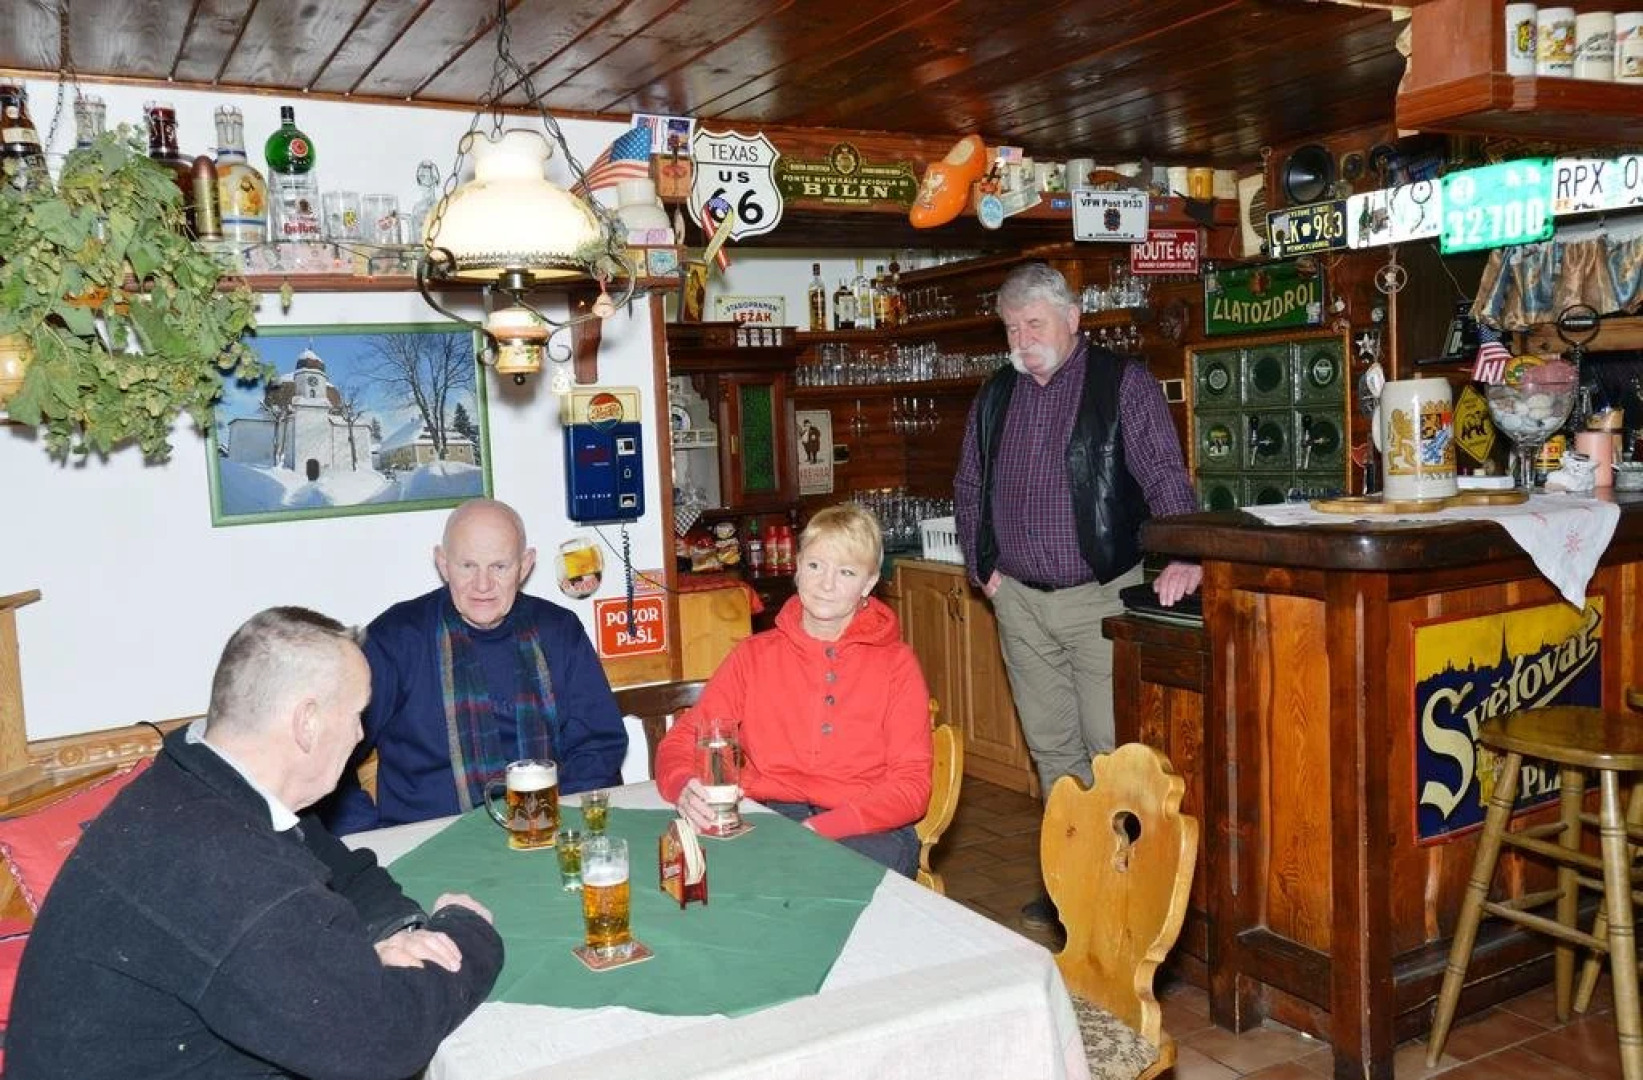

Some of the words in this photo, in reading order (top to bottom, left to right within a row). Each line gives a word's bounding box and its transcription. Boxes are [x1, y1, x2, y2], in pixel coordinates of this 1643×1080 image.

[709, 143, 759, 162] TEXAS
[719, 170, 750, 184] US
[783, 174, 811, 183] FONTE
[814, 176, 858, 184] NATURALE
[1557, 161, 1605, 199] RPX
[803, 183, 889, 198] BILIN
[1081, 198, 1100, 208] VFW
[1102, 199, 1121, 208] Post
[1133, 241, 1175, 260] ROUTE
[1182, 242, 1196, 260] 66
